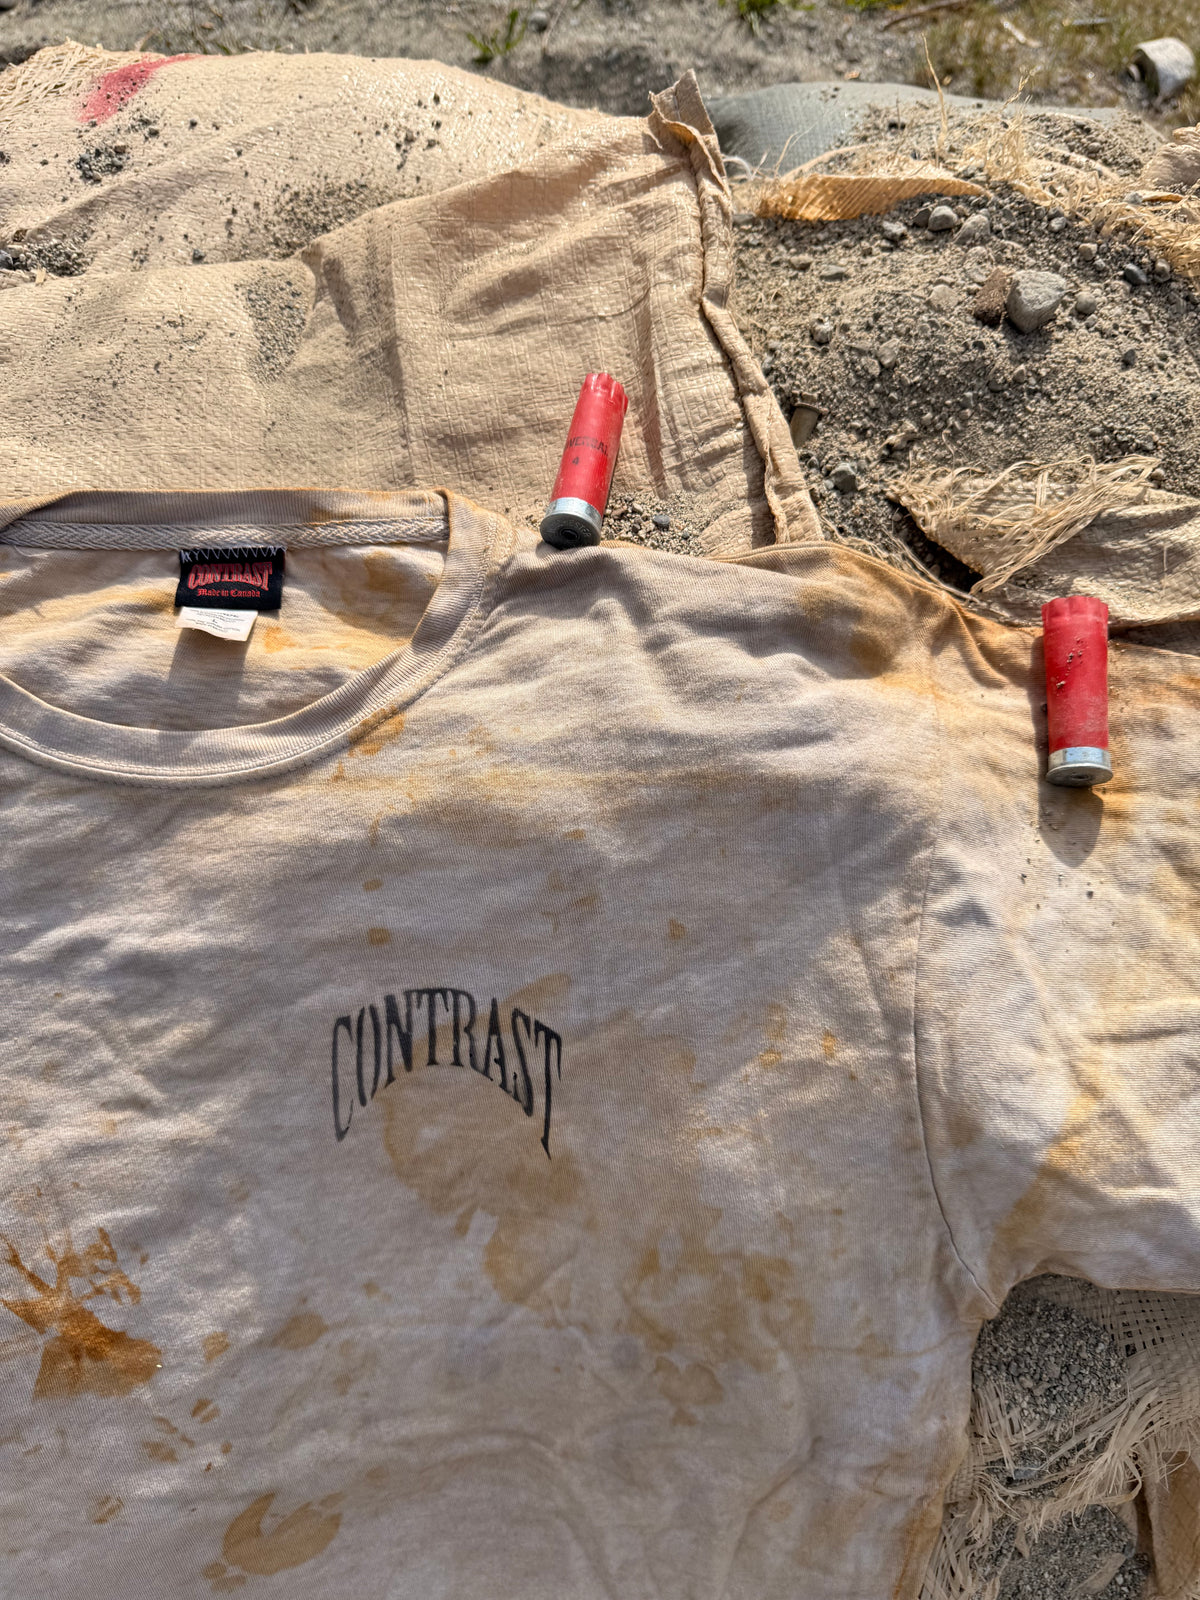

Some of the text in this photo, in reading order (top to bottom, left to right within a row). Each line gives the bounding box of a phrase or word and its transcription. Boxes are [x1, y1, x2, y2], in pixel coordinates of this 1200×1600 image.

[572, 456, 579, 465] 4
[188, 562, 273, 591] CONTRAST
[197, 588, 261, 598] Made in Canada
[331, 987, 562, 1160] CONTRAST
